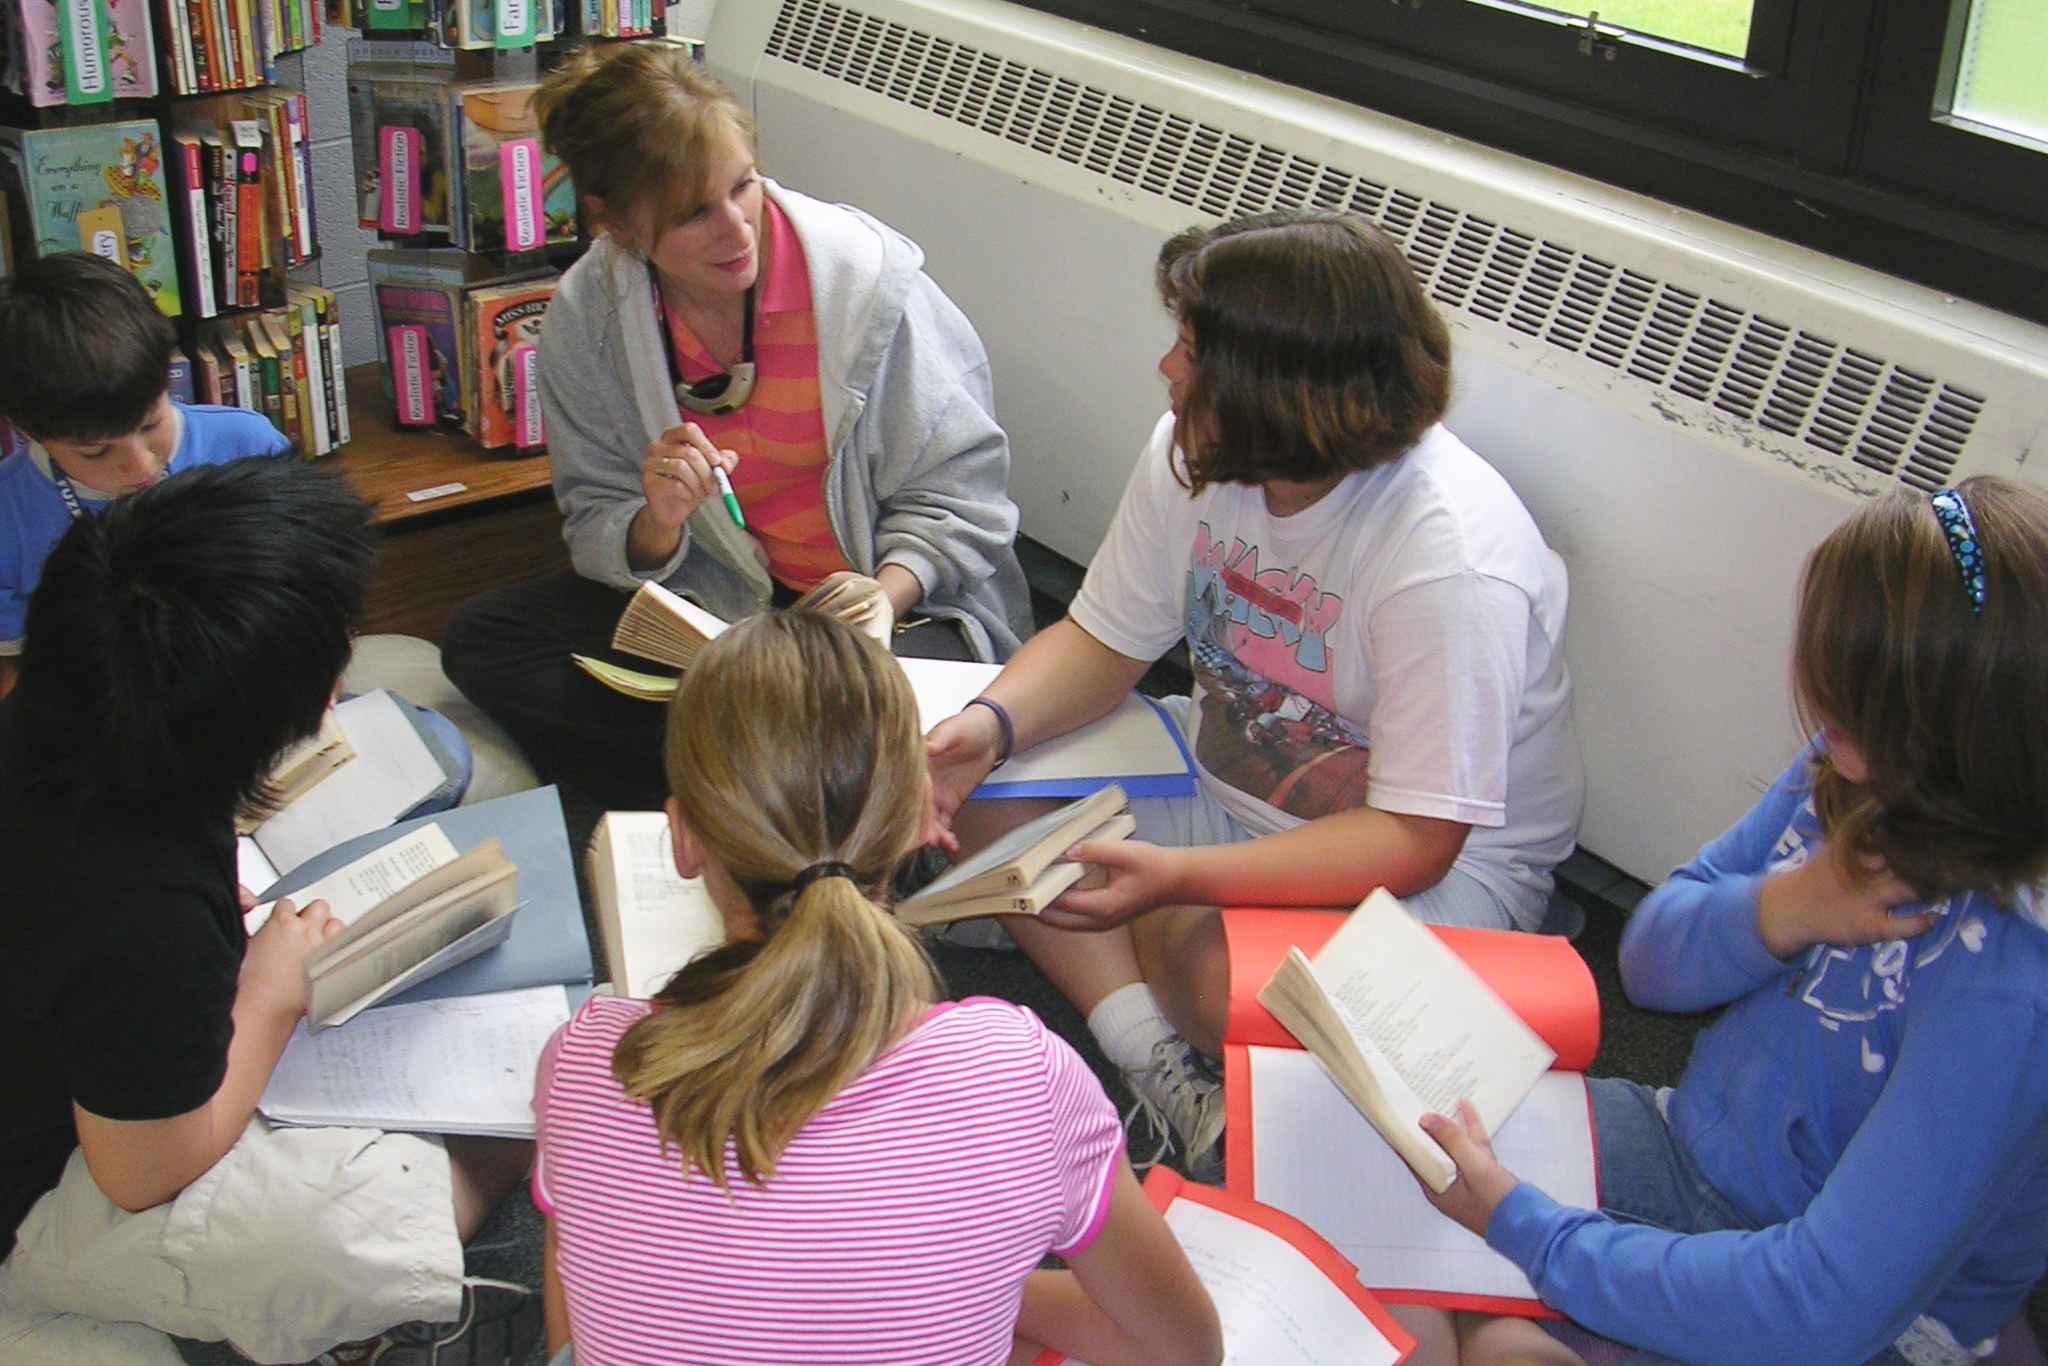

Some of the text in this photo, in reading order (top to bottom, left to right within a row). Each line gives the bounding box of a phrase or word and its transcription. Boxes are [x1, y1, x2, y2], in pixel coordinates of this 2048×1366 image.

[37, 157, 103, 178] Everything
[224, 176, 237, 215] Rascal
[393, 133, 408, 227] Realistic Fiction
[512, 148, 532, 244] Realistic Fiction
[404, 331, 423, 419] Realistic Fiction
[525, 354, 539, 443] Realistic Fiction
